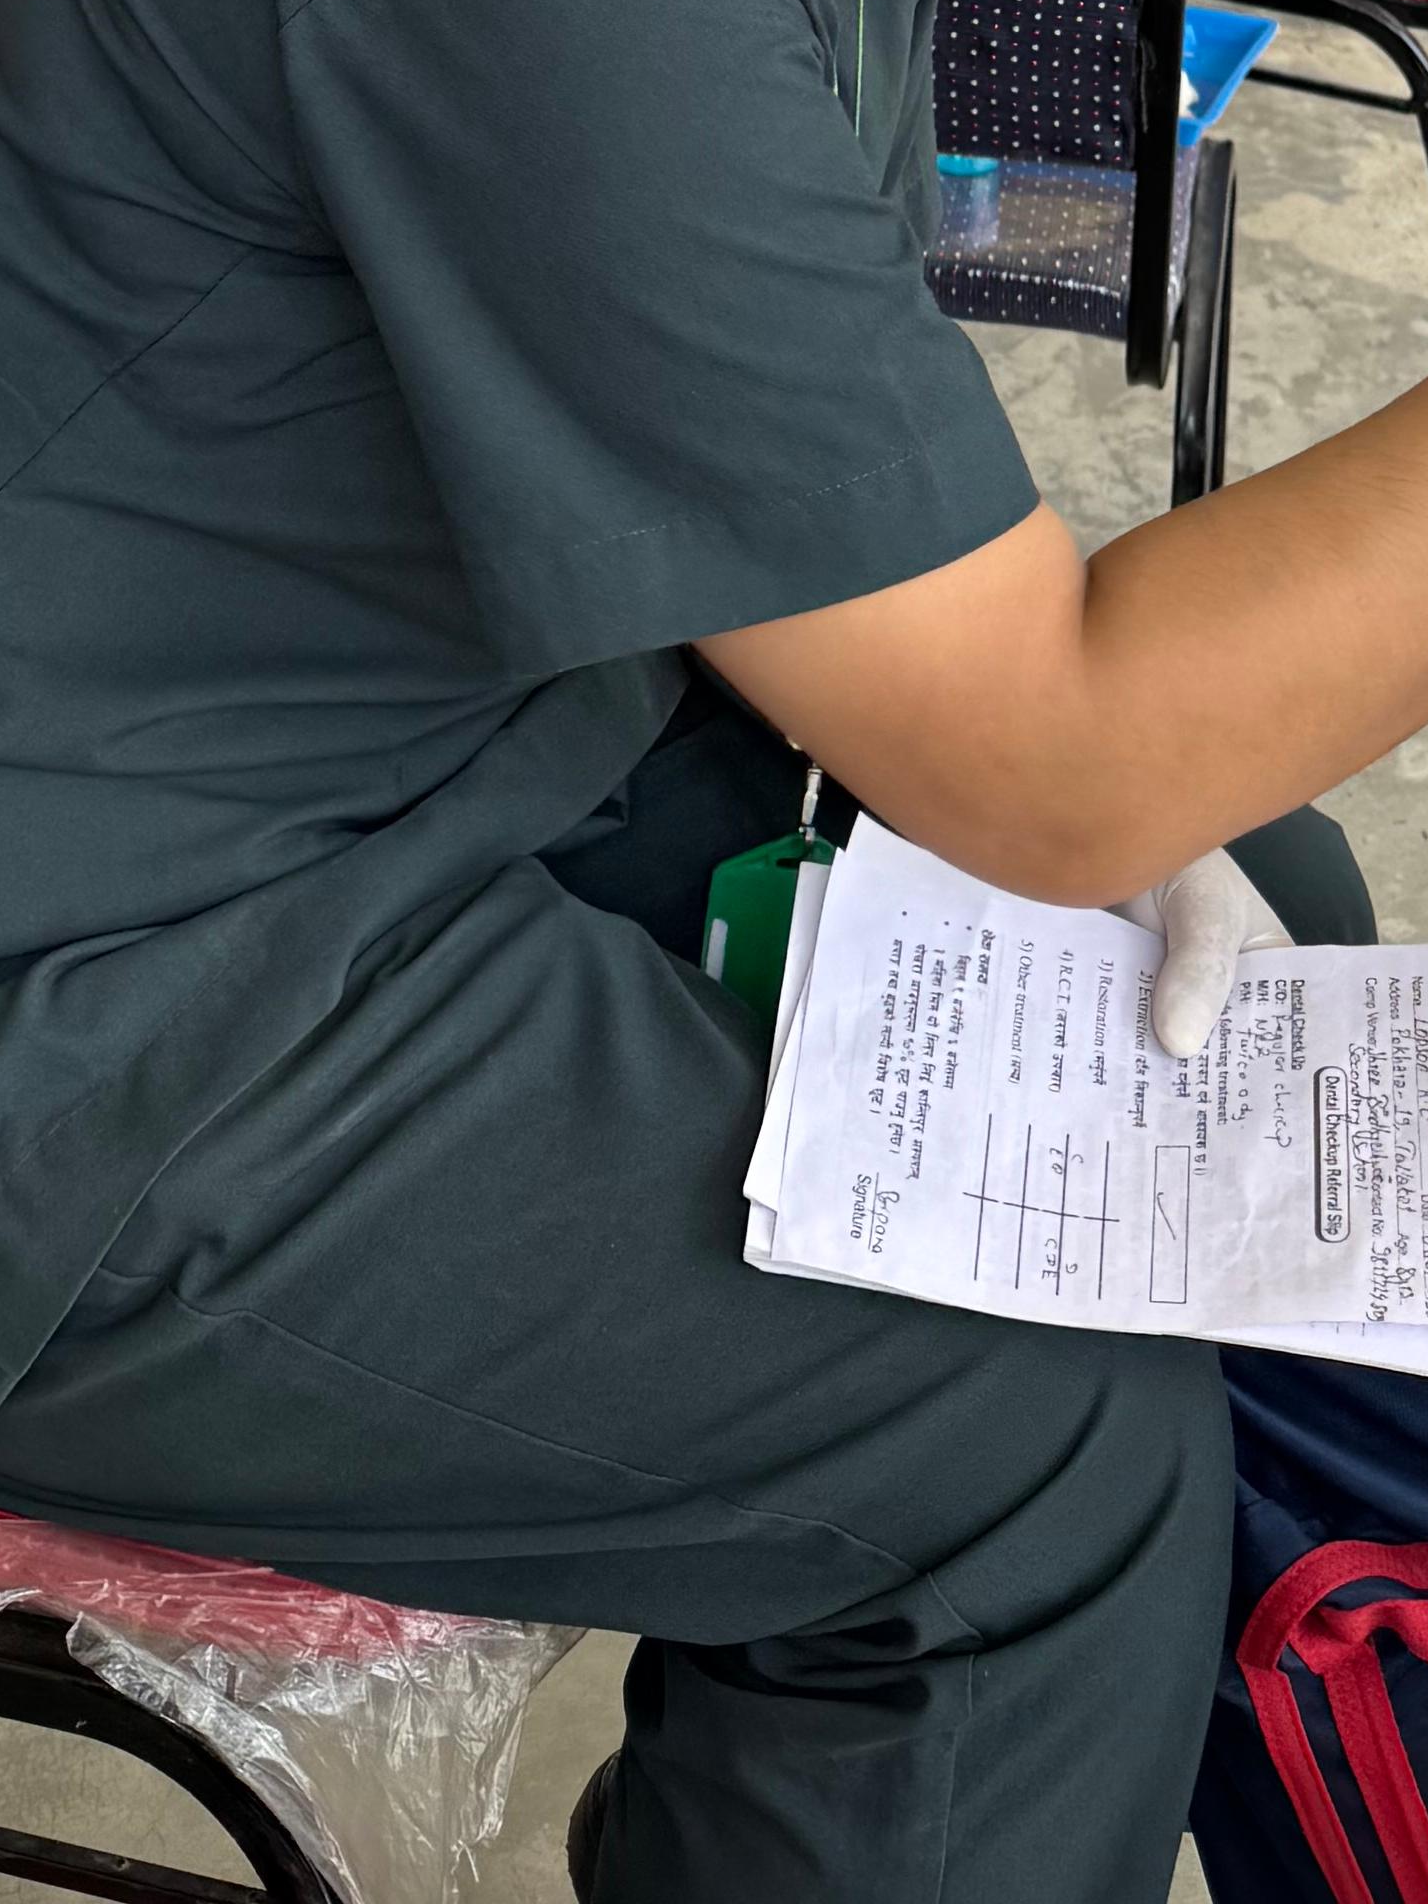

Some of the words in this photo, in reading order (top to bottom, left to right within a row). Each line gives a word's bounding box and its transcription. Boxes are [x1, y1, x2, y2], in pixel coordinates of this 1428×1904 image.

[1017, 956, 1033, 991] Other
[1094, 976, 1113, 1047] Restoration
[1135, 986, 1151, 1050] Extraction
[1292, 980, 1305, 1015] Dental
[1389, 977, 1402, 1019] Address
[1011, 994, 1026, 1052] treatment
[1216, 1018, 1232, 1068] following
[1292, 1018, 1306, 1053] Check
[1326, 1076, 1339, 1111] Dental
[1325, 1114, 1342, 1166] Checkup
[850, 1174, 872, 1239] Signature
[1326, 1169, 1342, 1211] Referral
[1324, 1214, 1342, 1236] Slip
